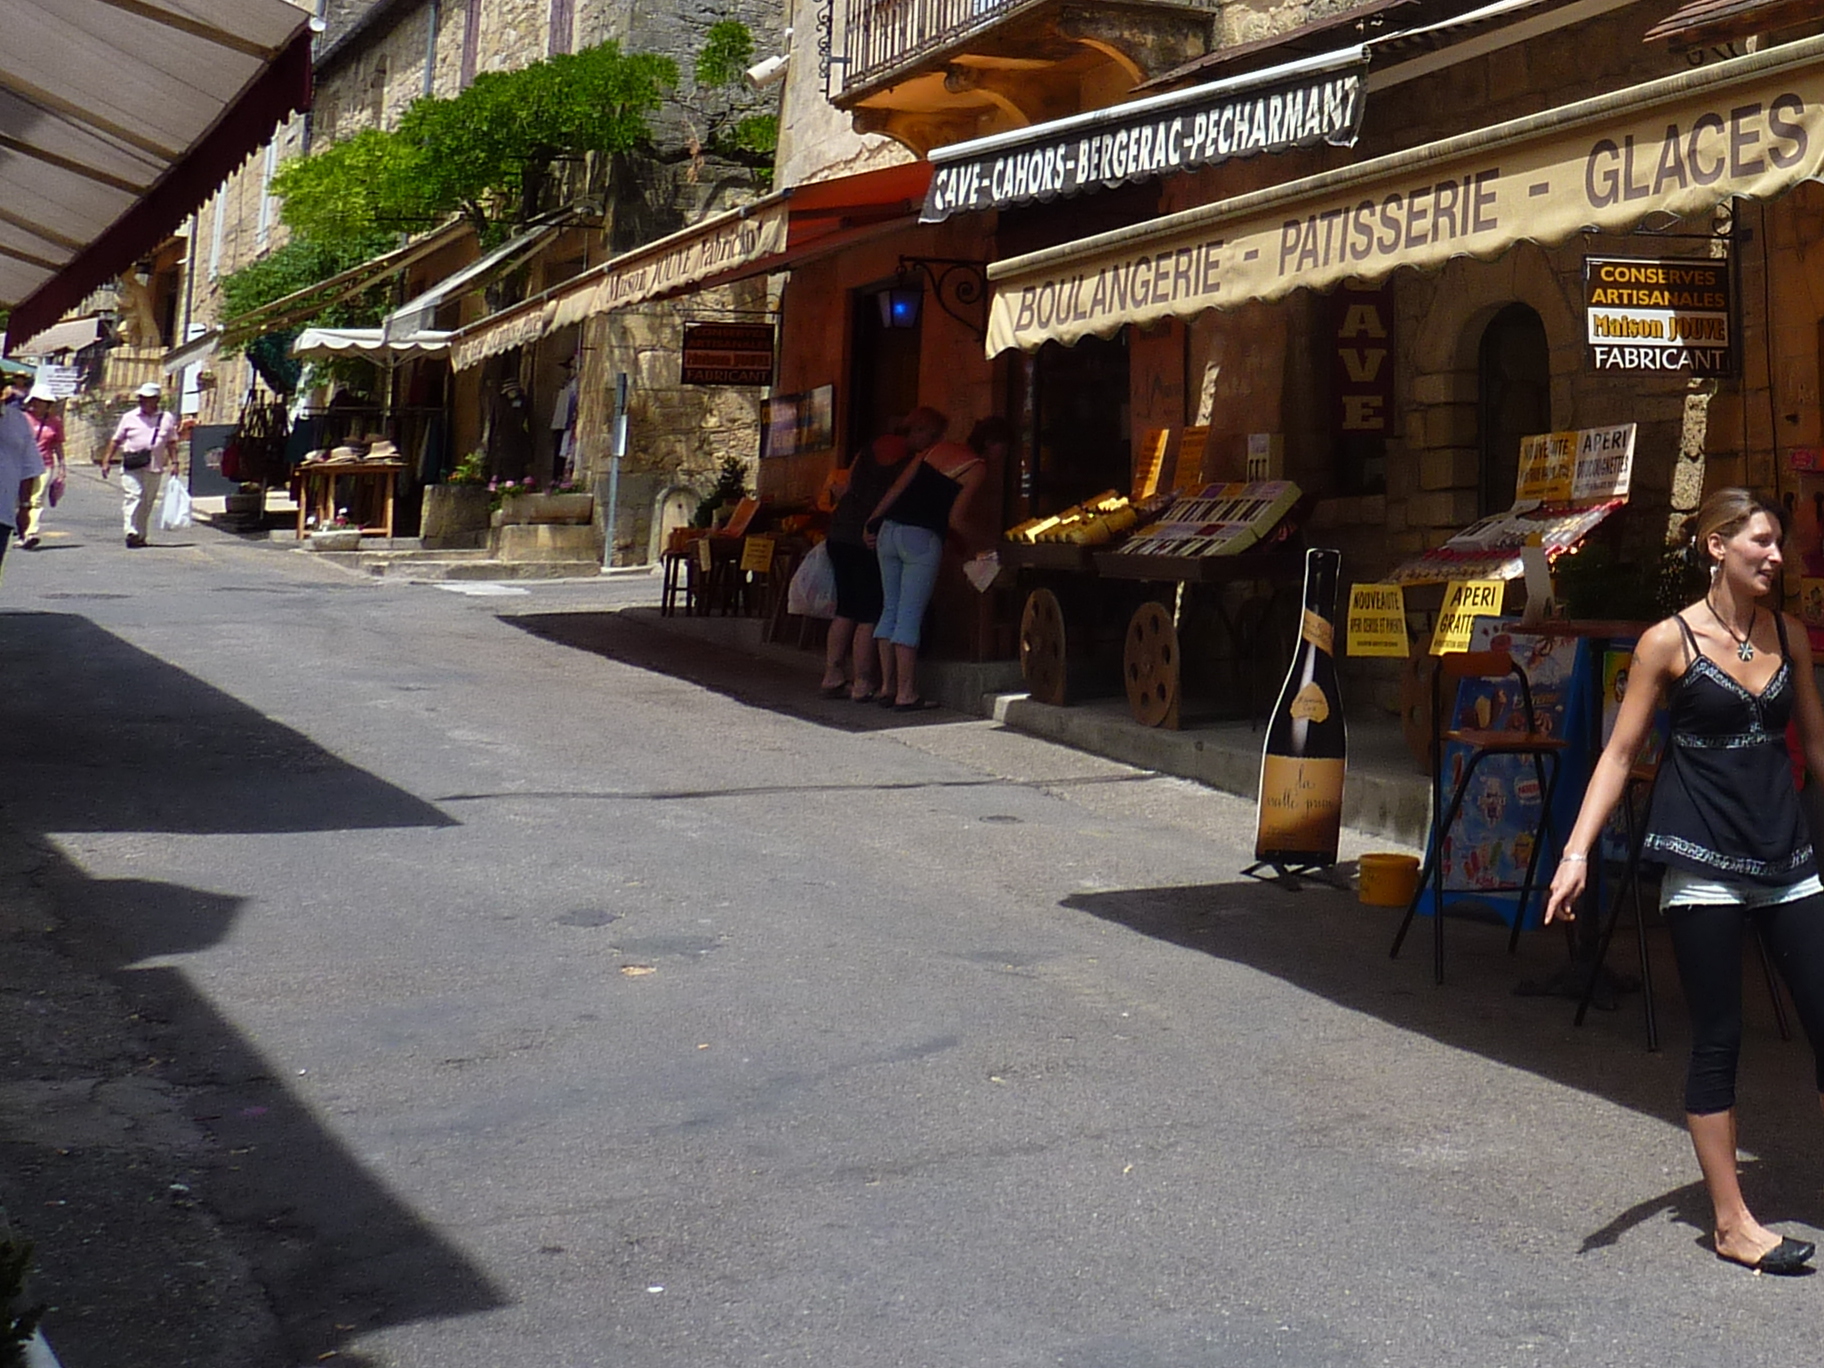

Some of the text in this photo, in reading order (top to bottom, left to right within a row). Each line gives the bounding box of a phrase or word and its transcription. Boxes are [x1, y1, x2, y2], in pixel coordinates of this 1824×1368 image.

[1014, 238, 1226, 333] BOULANGERIE
[1278, 168, 1499, 276] PATISSERIE
[1585, 92, 1809, 209] GLACES
[1600, 266, 1716, 286] CONSERVES
[1591, 288, 1726, 307] ARTISANALES
[1593, 313, 1726, 342] Maison JOUVE
[1337, 277, 1388, 430] AVE
[1593, 346, 1725, 371] FABRICANT
[686, 369, 769, 382] FABRICANT
[1450, 586, 1496, 607] APERI
